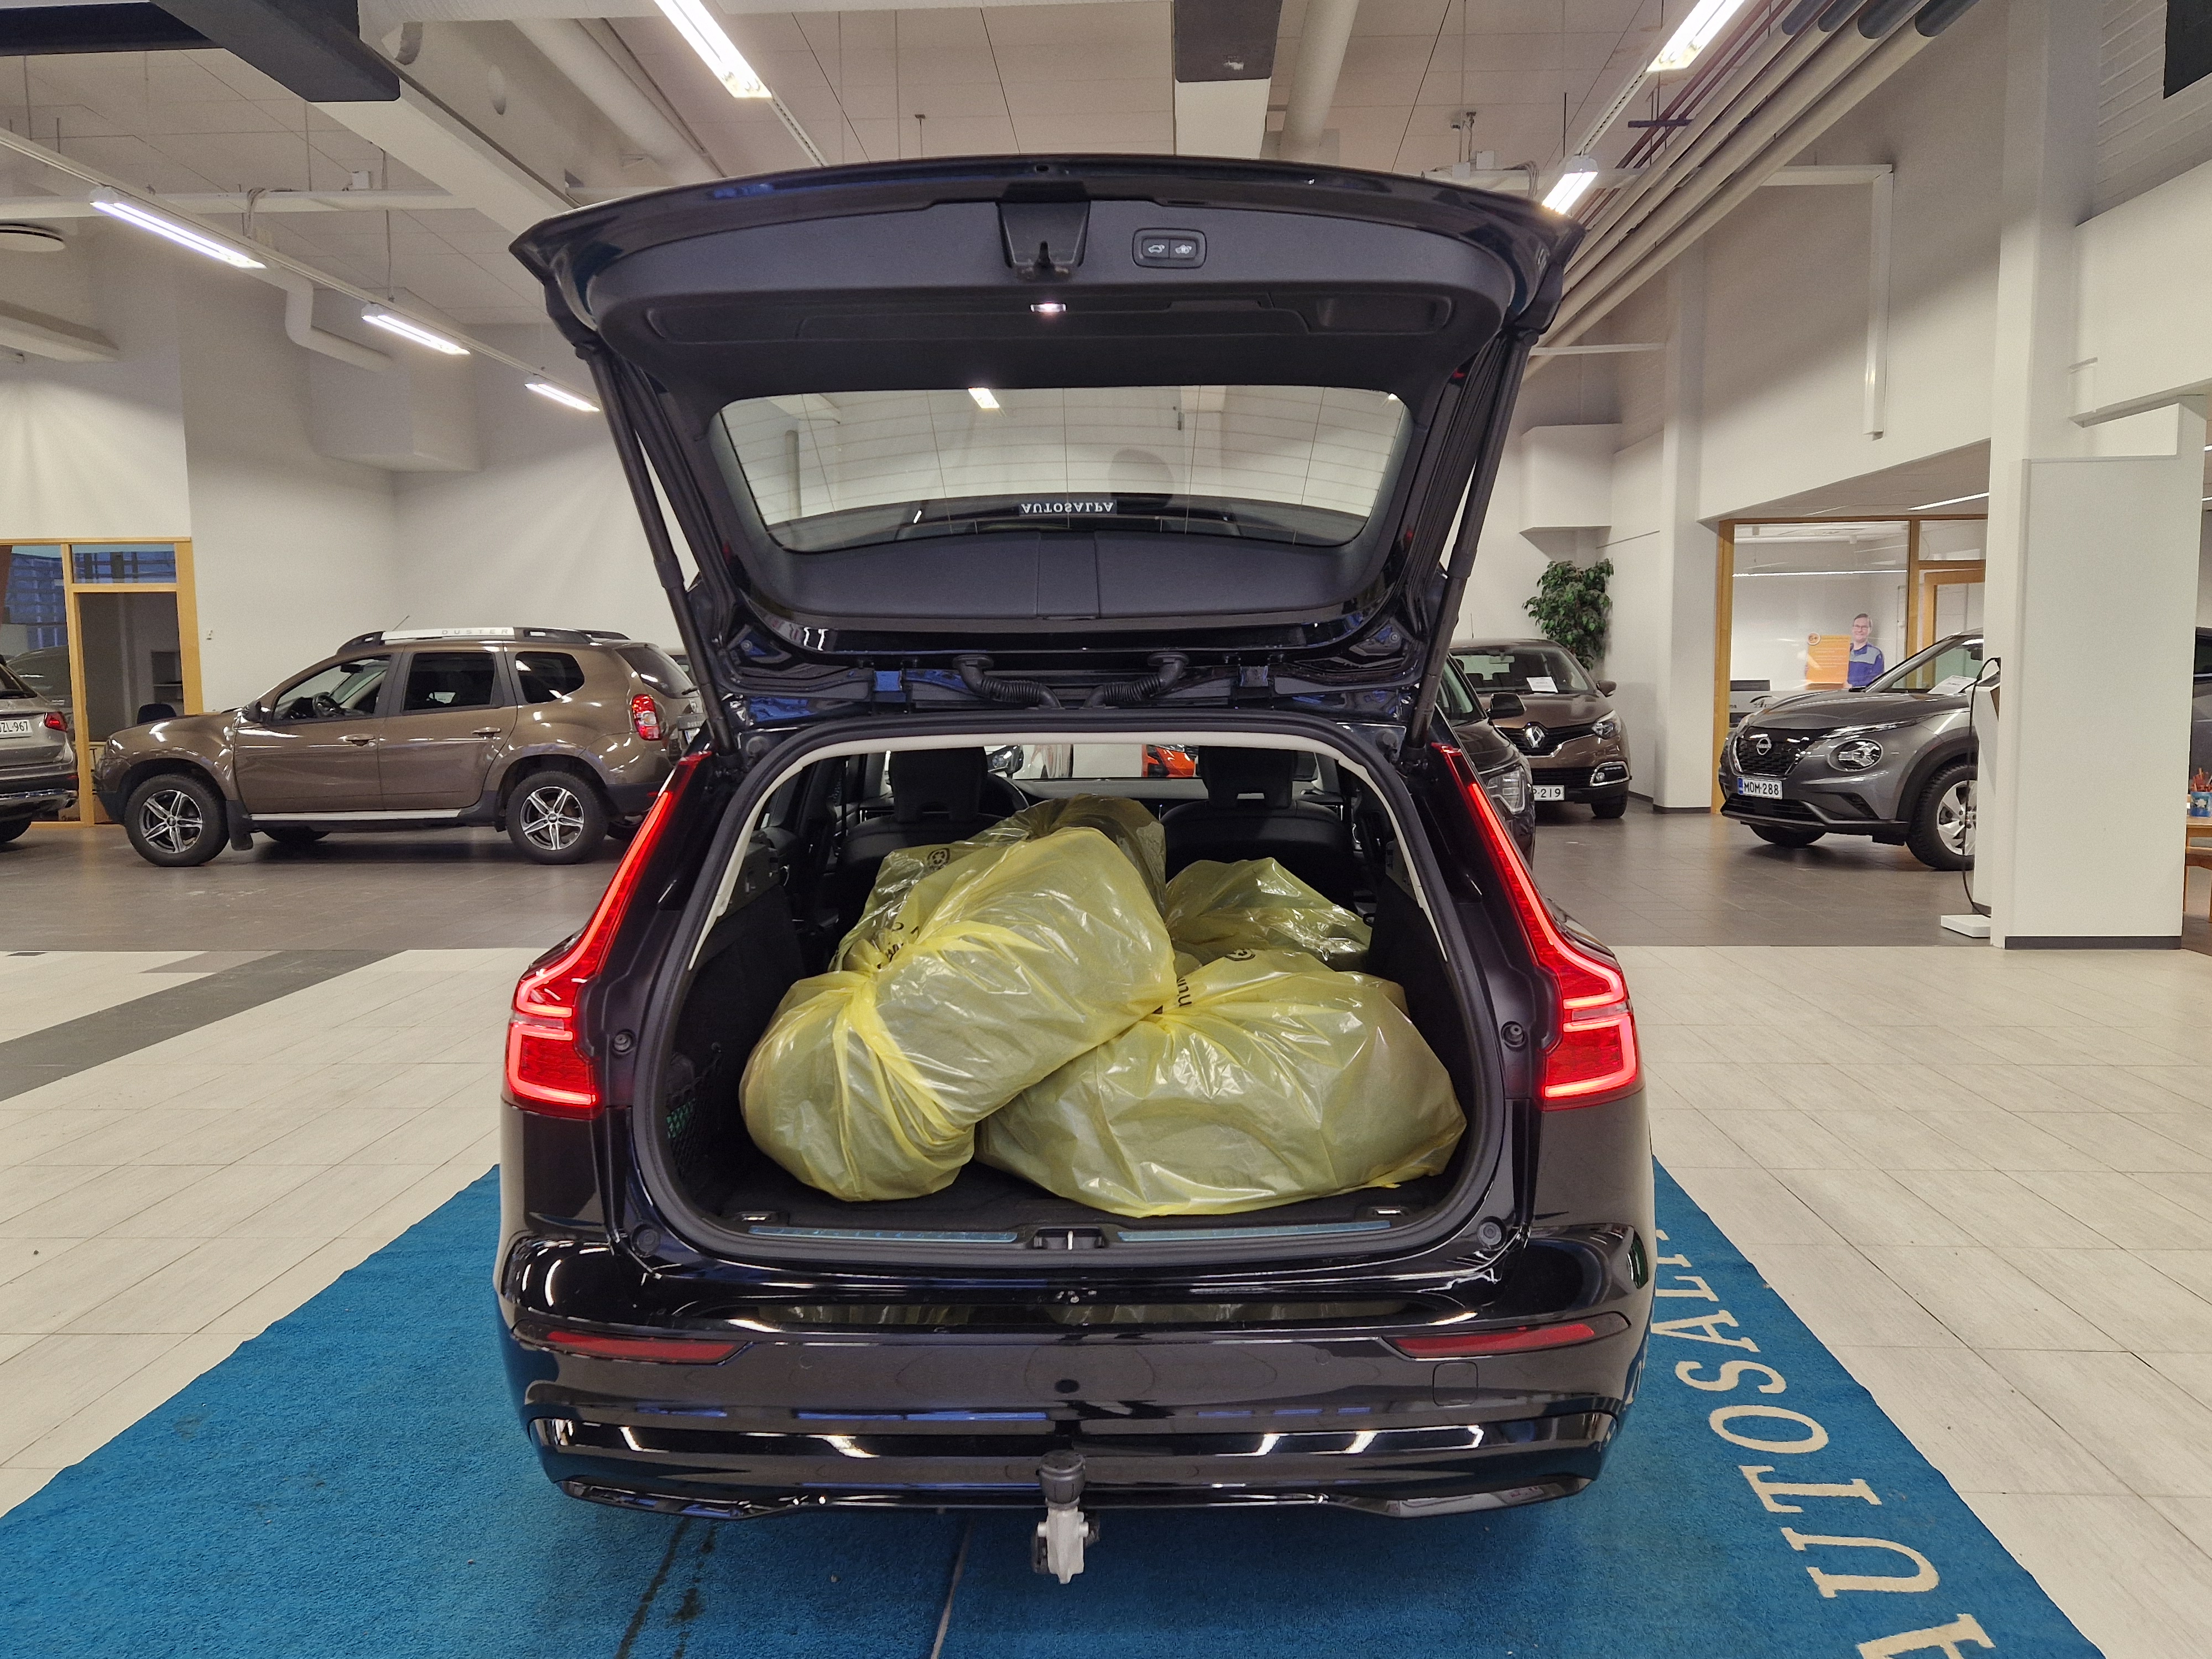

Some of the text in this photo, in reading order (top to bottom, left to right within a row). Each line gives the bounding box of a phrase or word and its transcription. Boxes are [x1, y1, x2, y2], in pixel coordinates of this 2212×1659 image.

[0, 721, 28, 732] ZL-967
[1744, 780, 1779, 795] MOM-288
[1650, 1229, 1996, 1659] UTOSAL
